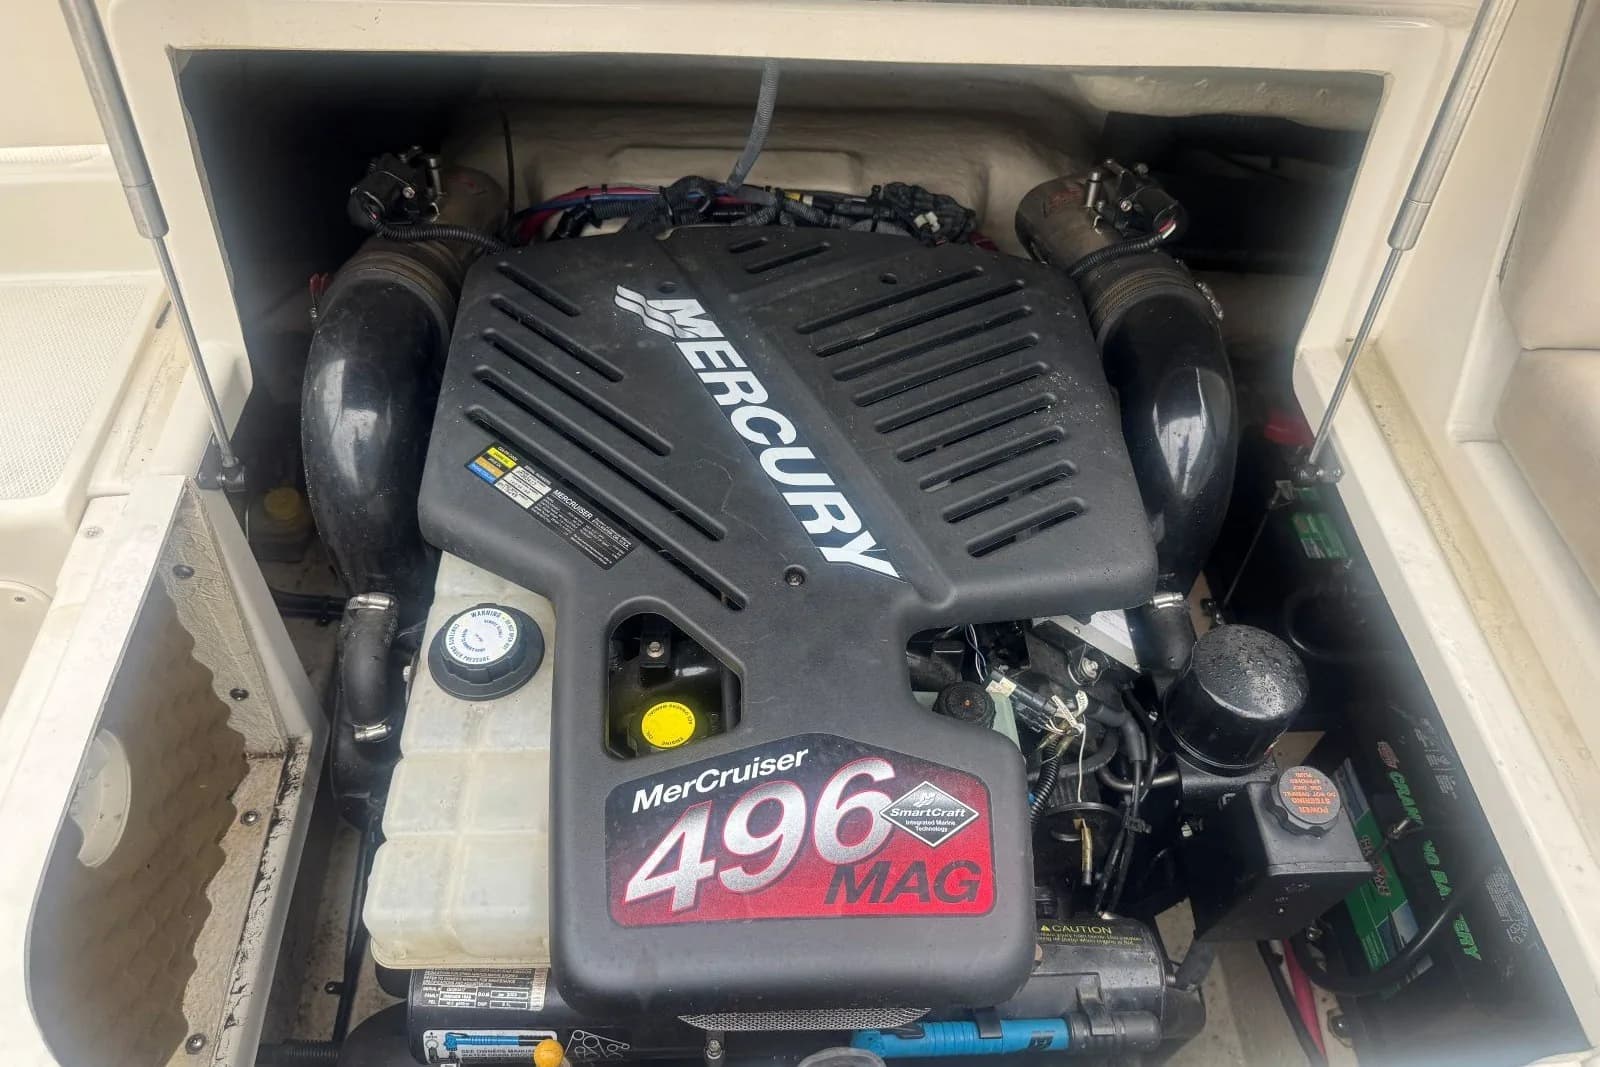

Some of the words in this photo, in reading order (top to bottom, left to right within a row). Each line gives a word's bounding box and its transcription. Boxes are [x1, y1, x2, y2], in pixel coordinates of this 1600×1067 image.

[614, 285, 900, 578] MERCURY
[554, 490, 593, 520] MERCRUISER
[632, 748, 809, 814] MerCruiser
[890, 808, 966, 817] SmartCraft
[1298, 806, 1329, 814] POWER
[624, 757, 896, 912] 496
[824, 860, 982, 905] MAG
[1052, 925, 1112, 934] CAUTION
[1430, 869, 1482, 961] BAERY
